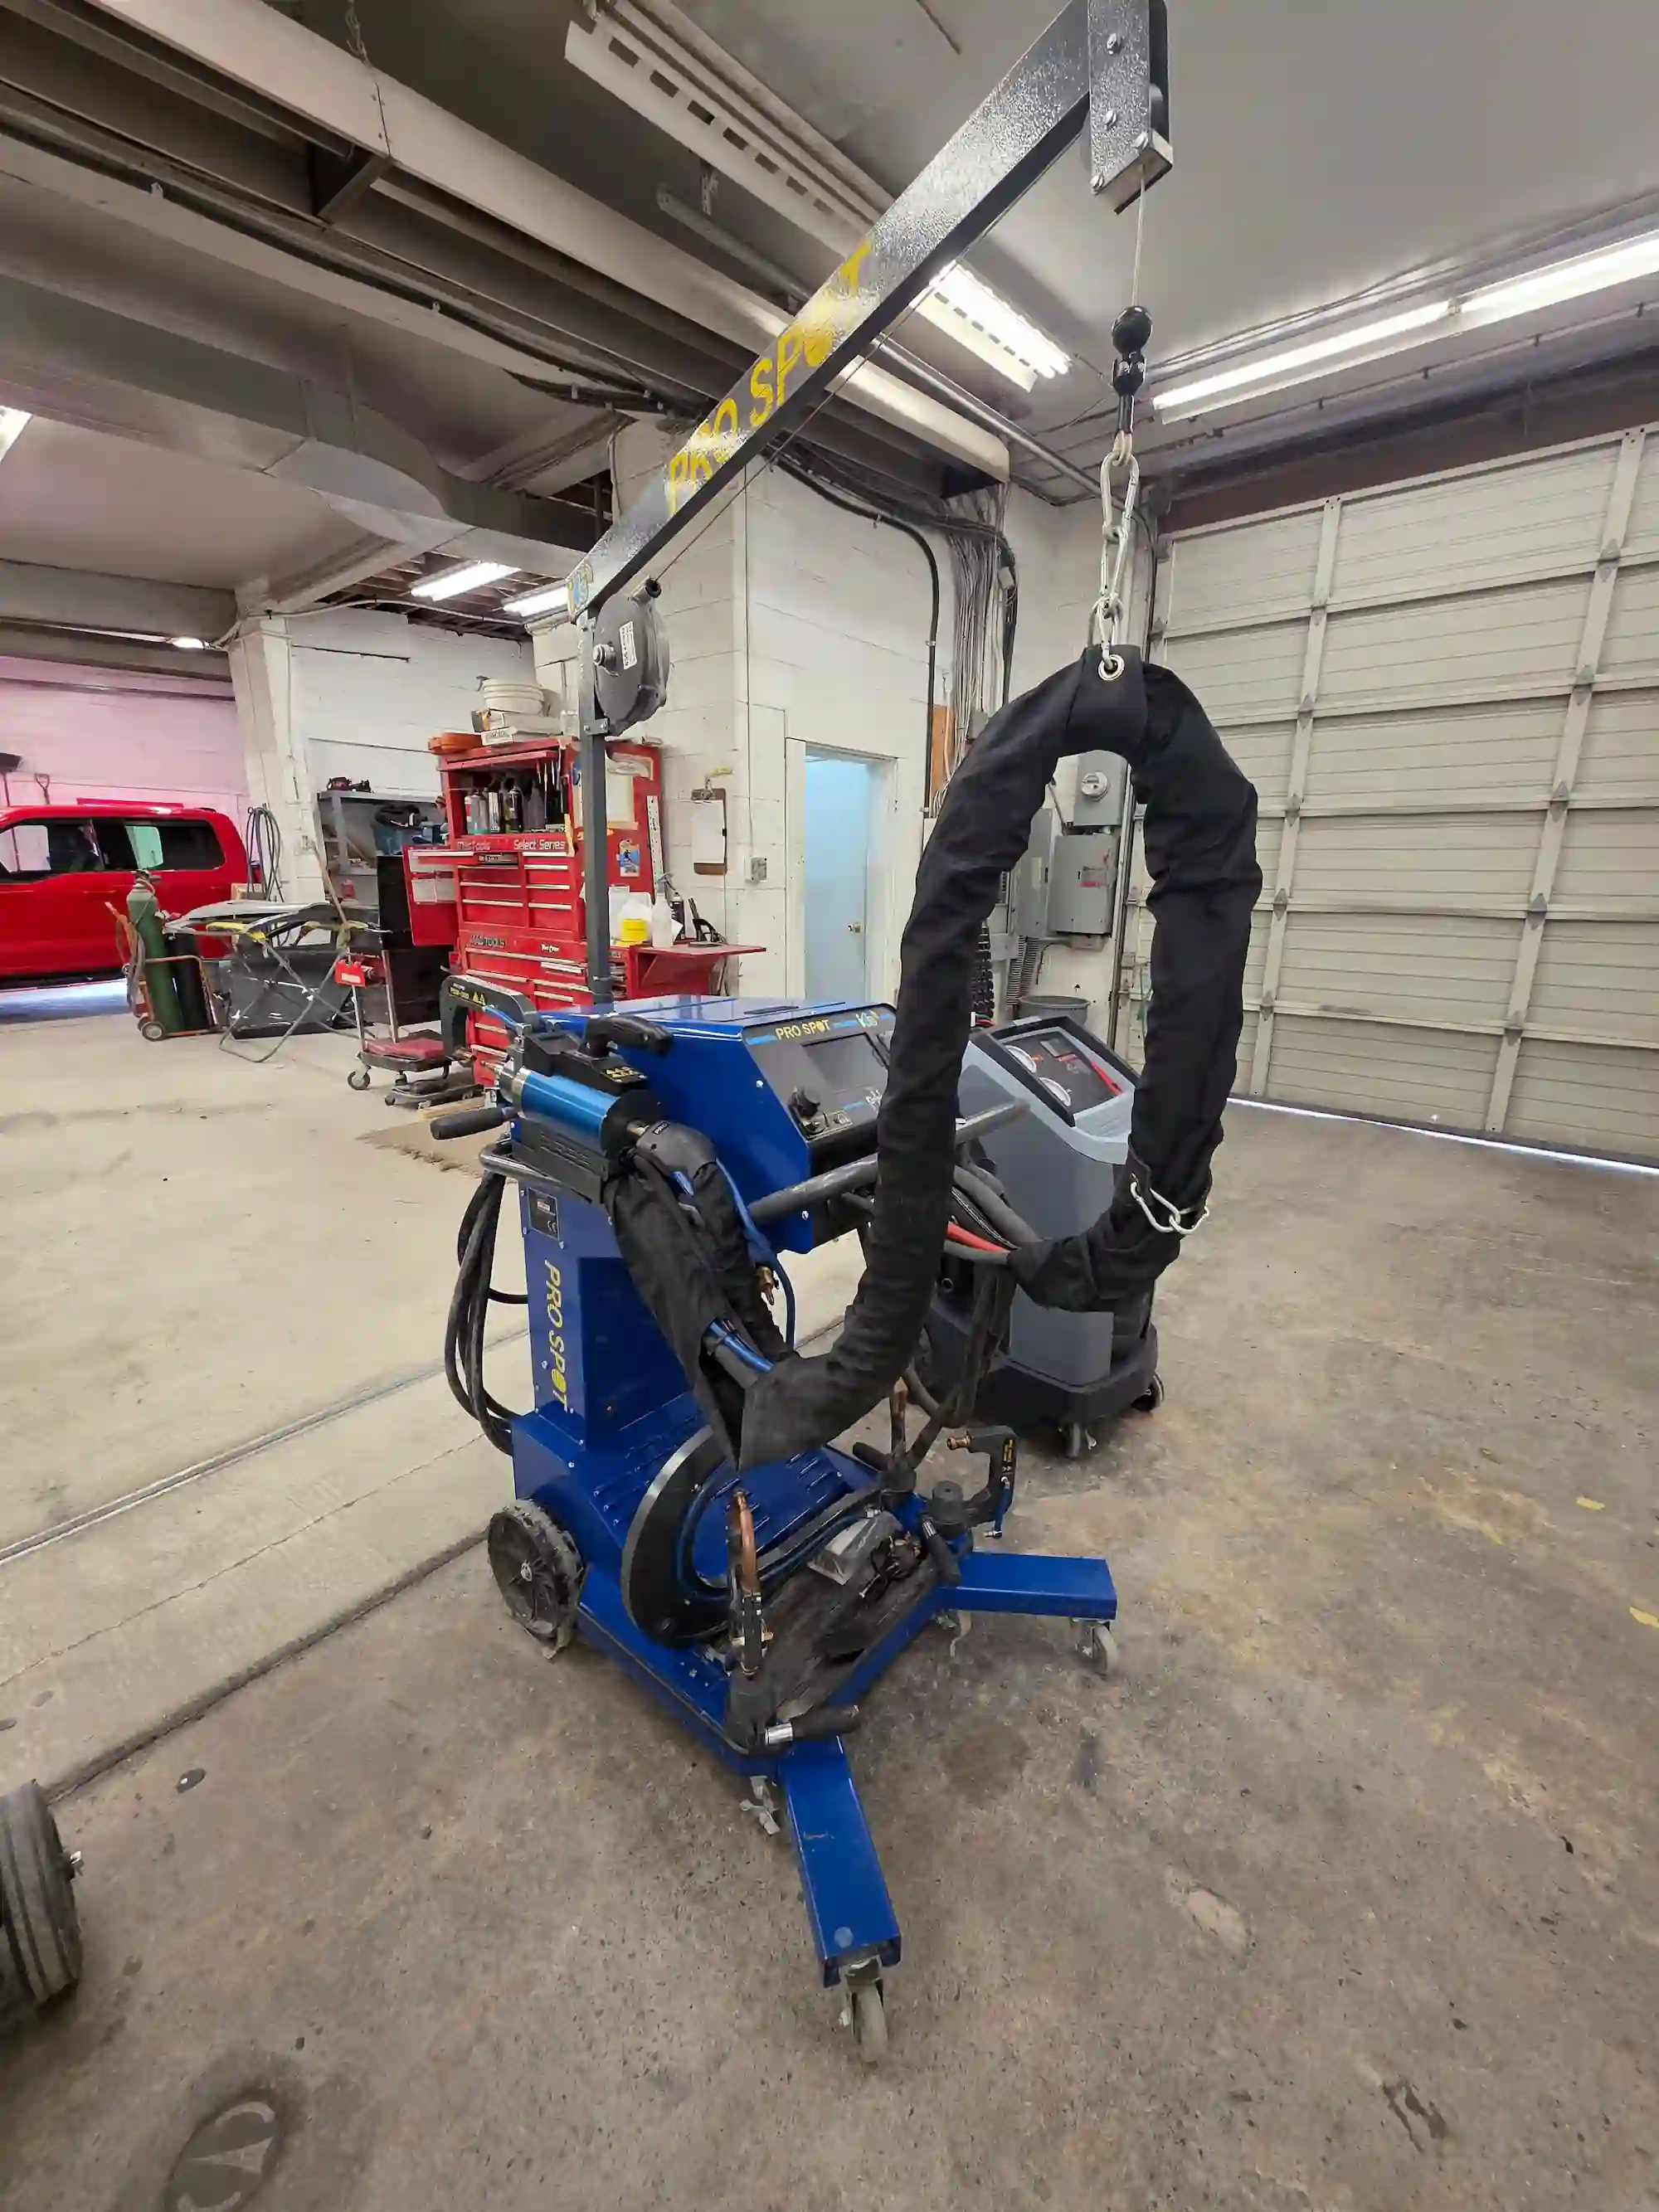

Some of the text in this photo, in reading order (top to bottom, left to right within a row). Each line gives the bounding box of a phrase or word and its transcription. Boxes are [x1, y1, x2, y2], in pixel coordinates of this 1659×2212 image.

[667, 236, 871, 518] PRO SPOT
[513, 839, 537, 850] Select
[539, 839, 565, 850] Series
[776, 1018, 830, 1040] PRO SPOT
[544, 1259, 569, 1412] PRO SPOT
